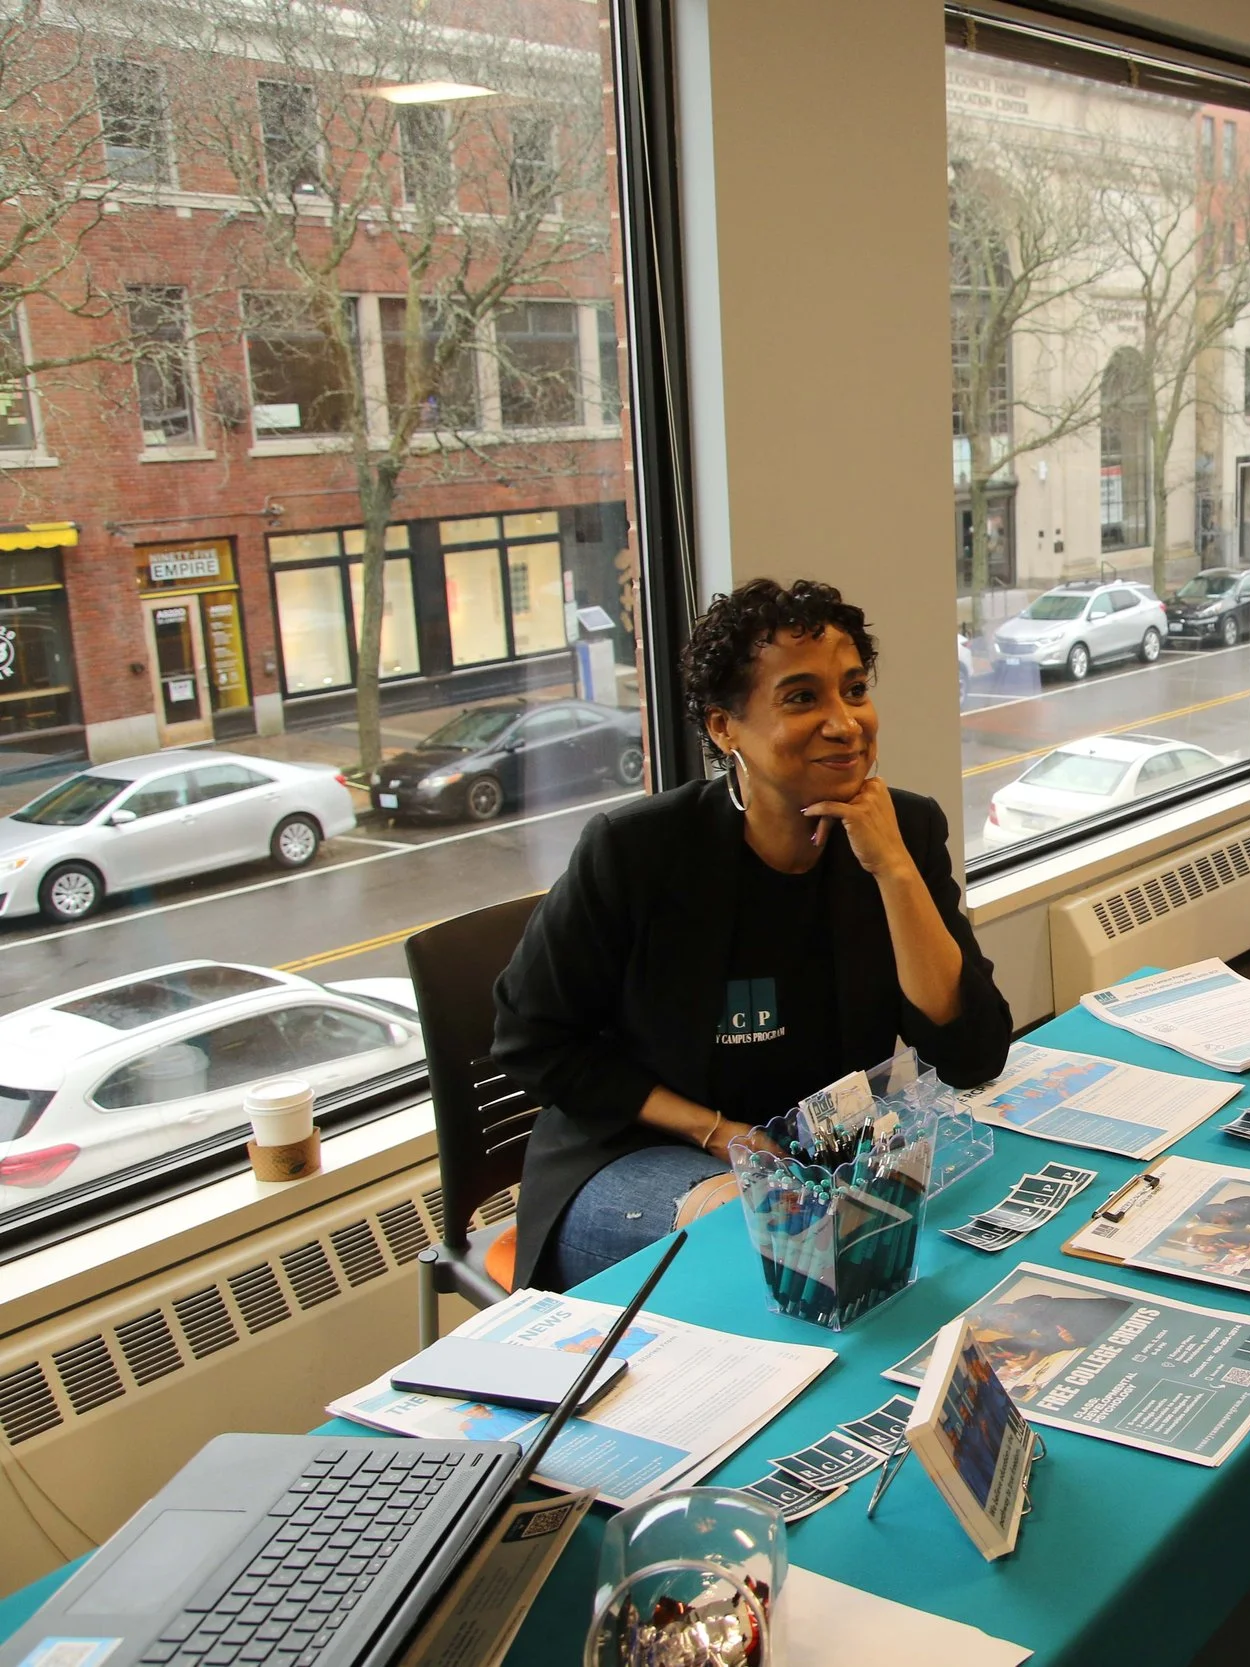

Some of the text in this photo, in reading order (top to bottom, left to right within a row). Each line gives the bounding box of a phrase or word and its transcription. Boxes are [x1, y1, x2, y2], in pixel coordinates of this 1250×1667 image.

[948, 91, 993, 107] DUCATION
[153, 560, 217, 578] EMPIRE
[721, 1033, 752, 1045] CAMPUS
[752, 1026, 786, 1043] PROGRAM
[517, 1310, 573, 1342] NEWS
[1035, 1307, 1163, 1412] FREE COLLEGE CREDITS
[384, 1395, 428, 1417] THE
[1071, 1396, 1102, 1419] CLASS:
[1081, 1371, 1139, 1422] DEVELOPMENTAL
[1091, 1383, 1139, 1425] PSYCHOLOGY
[800, 1449, 856, 1479] RCP
